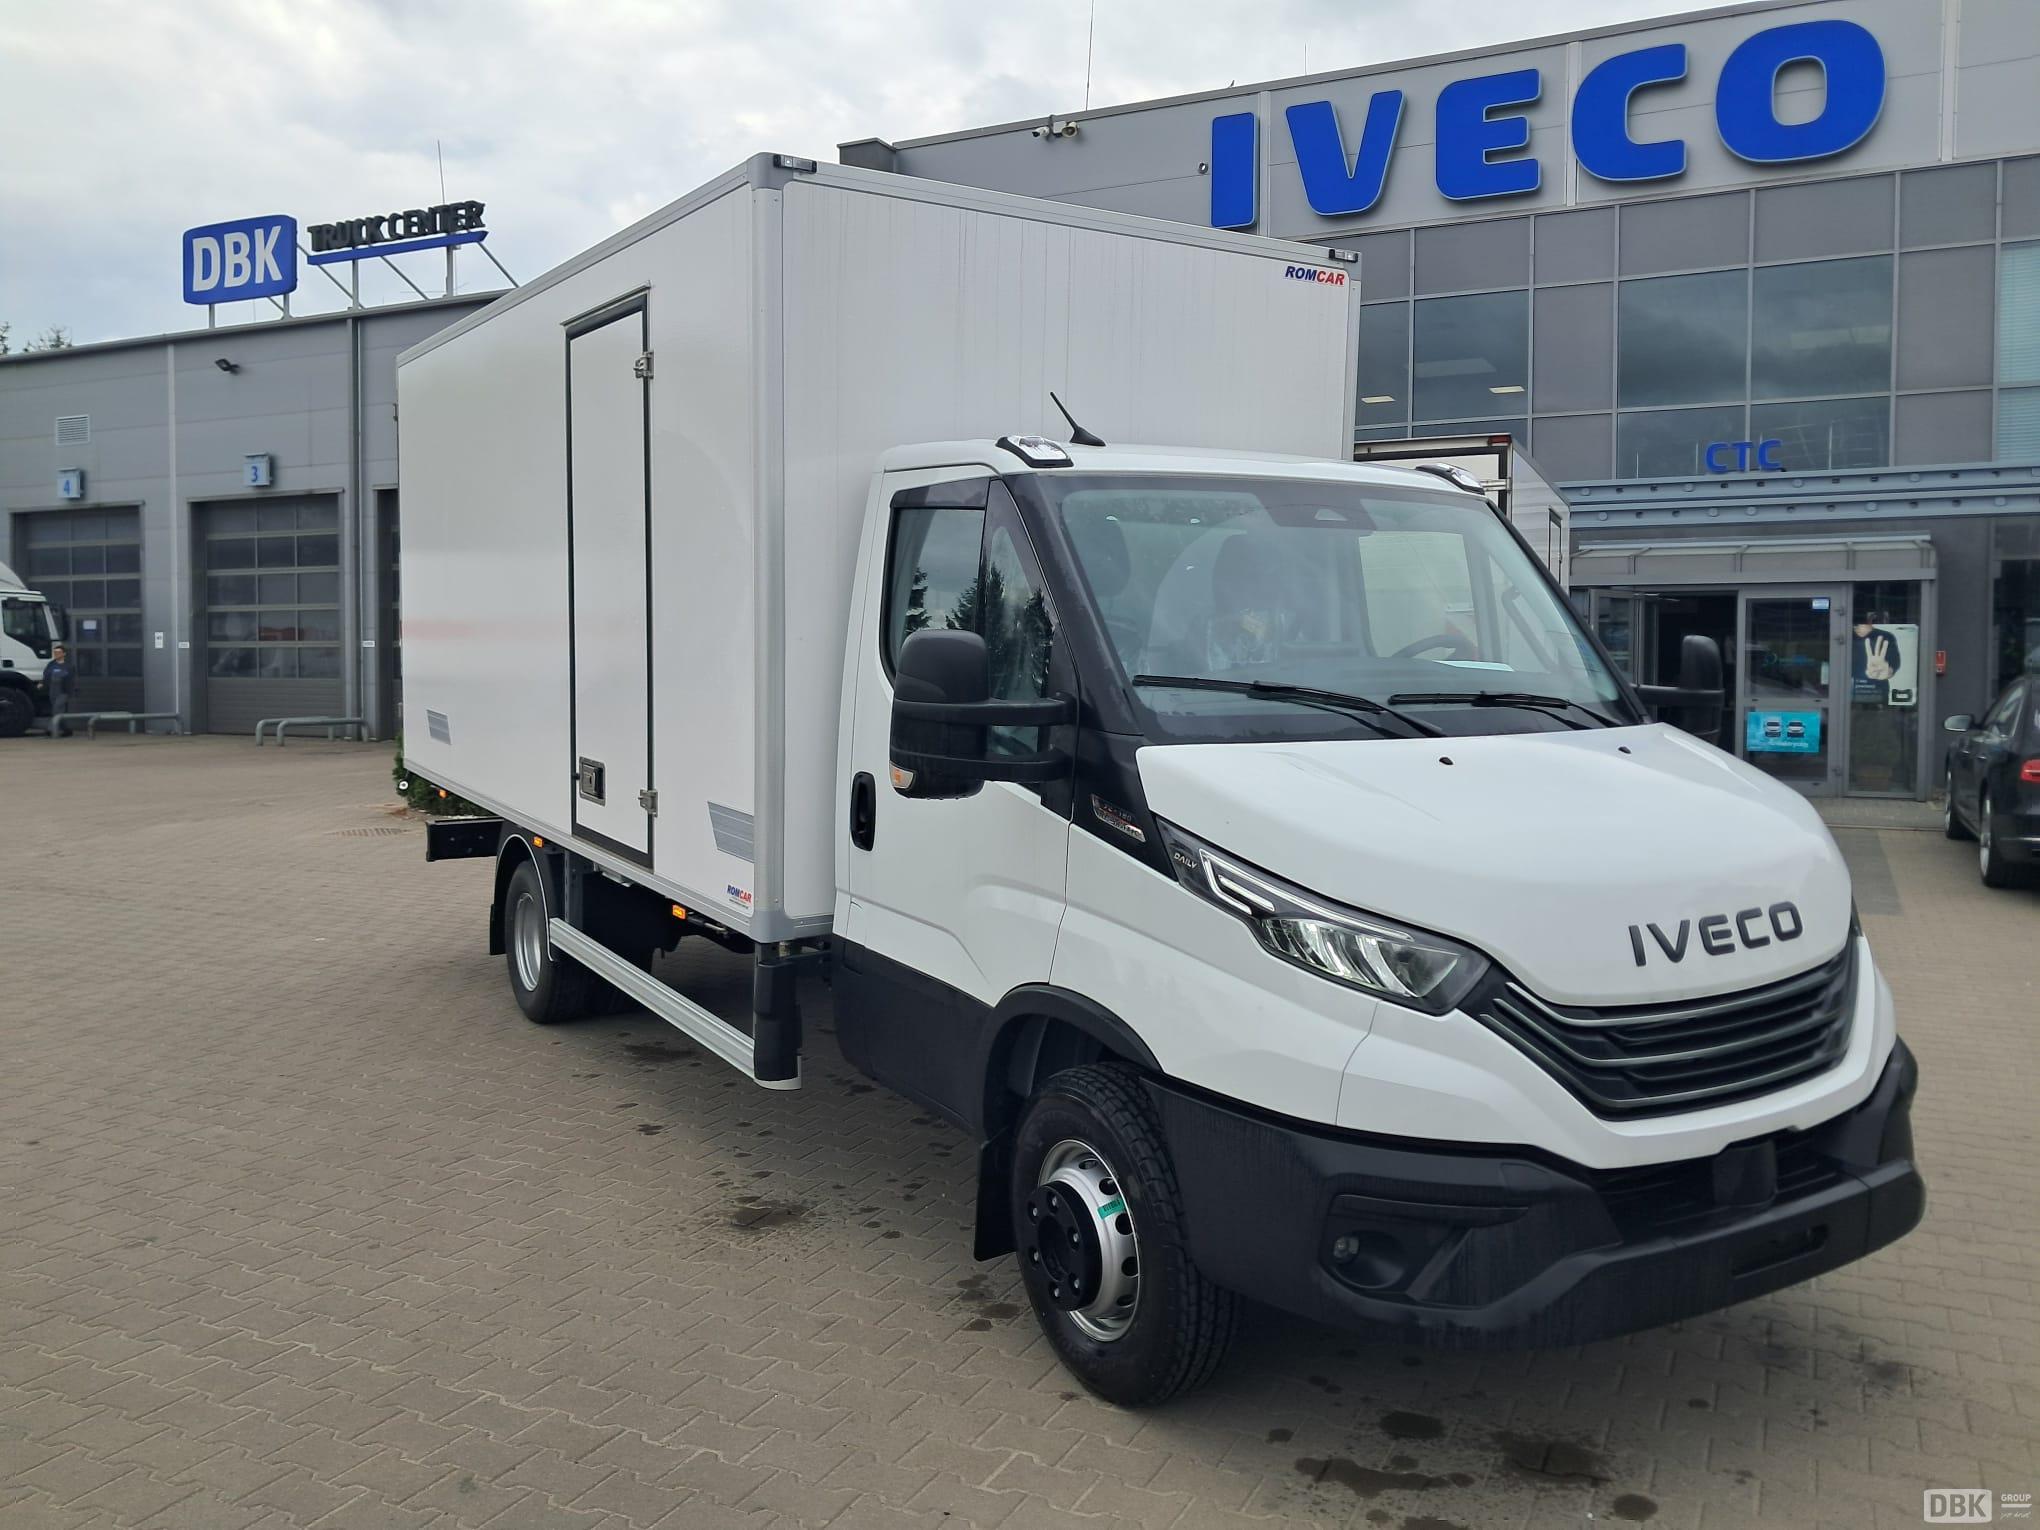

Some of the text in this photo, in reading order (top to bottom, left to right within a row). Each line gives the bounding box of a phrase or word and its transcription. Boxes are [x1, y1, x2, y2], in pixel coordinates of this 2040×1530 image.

[1210, 19, 1886, 228] IVECO
[306, 200, 486, 252] TRUCK CENTER
[192, 225, 283, 292] DBK
[1285, 265, 1345, 286] ROMCAR
[1706, 439, 1782, 474] CTC
[63, 480, 71, 495] 4
[251, 466, 259, 482] 3
[1173, 852, 1198, 869] DAILY
[727, 884, 752, 903] ROMCAR
[1628, 901, 1804, 967] IVECO
